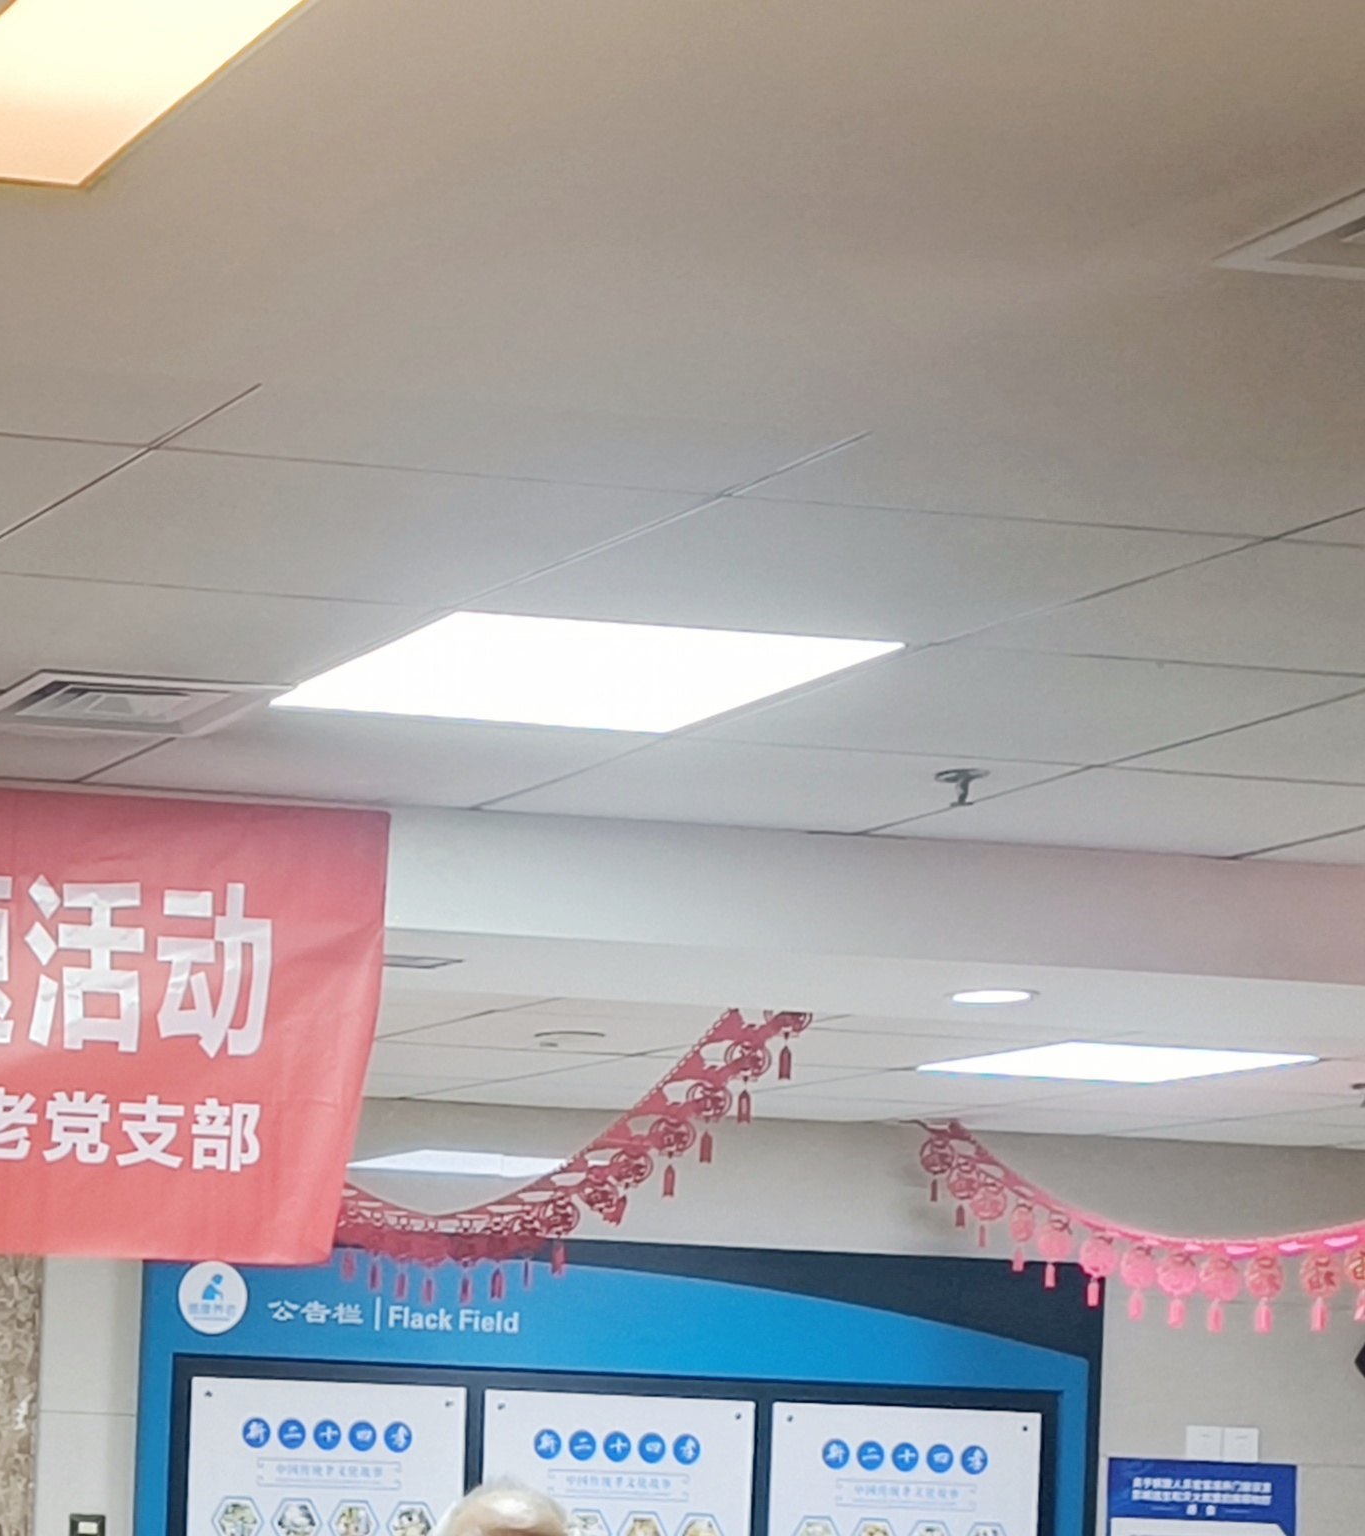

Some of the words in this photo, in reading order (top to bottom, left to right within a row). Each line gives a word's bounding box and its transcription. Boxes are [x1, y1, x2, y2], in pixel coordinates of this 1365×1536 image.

[268, 1300, 363, 1325] 公告栏
[388, 1305, 452, 1331] Flack
[459, 1308, 519, 1334] Field
